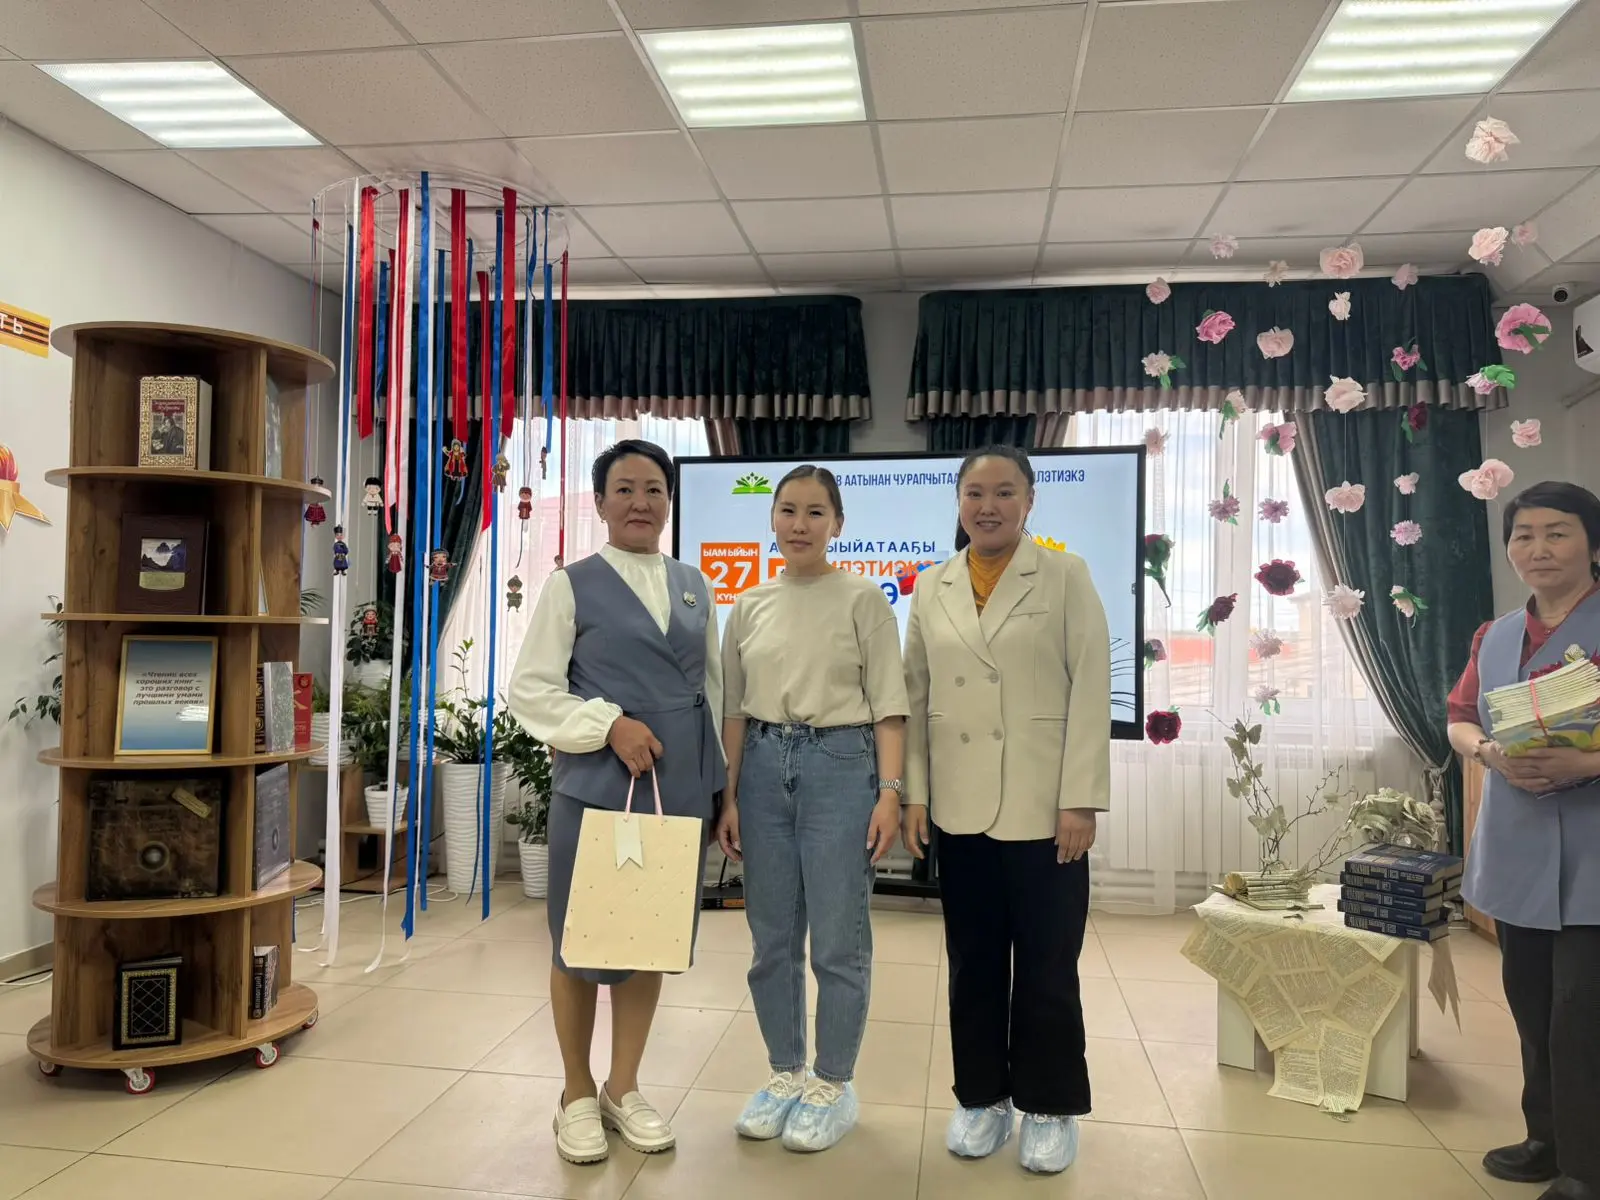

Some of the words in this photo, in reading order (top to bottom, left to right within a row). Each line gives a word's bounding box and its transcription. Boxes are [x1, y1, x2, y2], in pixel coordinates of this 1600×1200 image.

[844, 474, 891, 487] ААТЫНАН
[1033, 469, 1085, 483] ЛЭТИЭКЭ
[703, 548, 727, 557] ЫАМ
[728, 546, 759, 557] ЫЙЫН
[709, 561, 753, 589] 27
